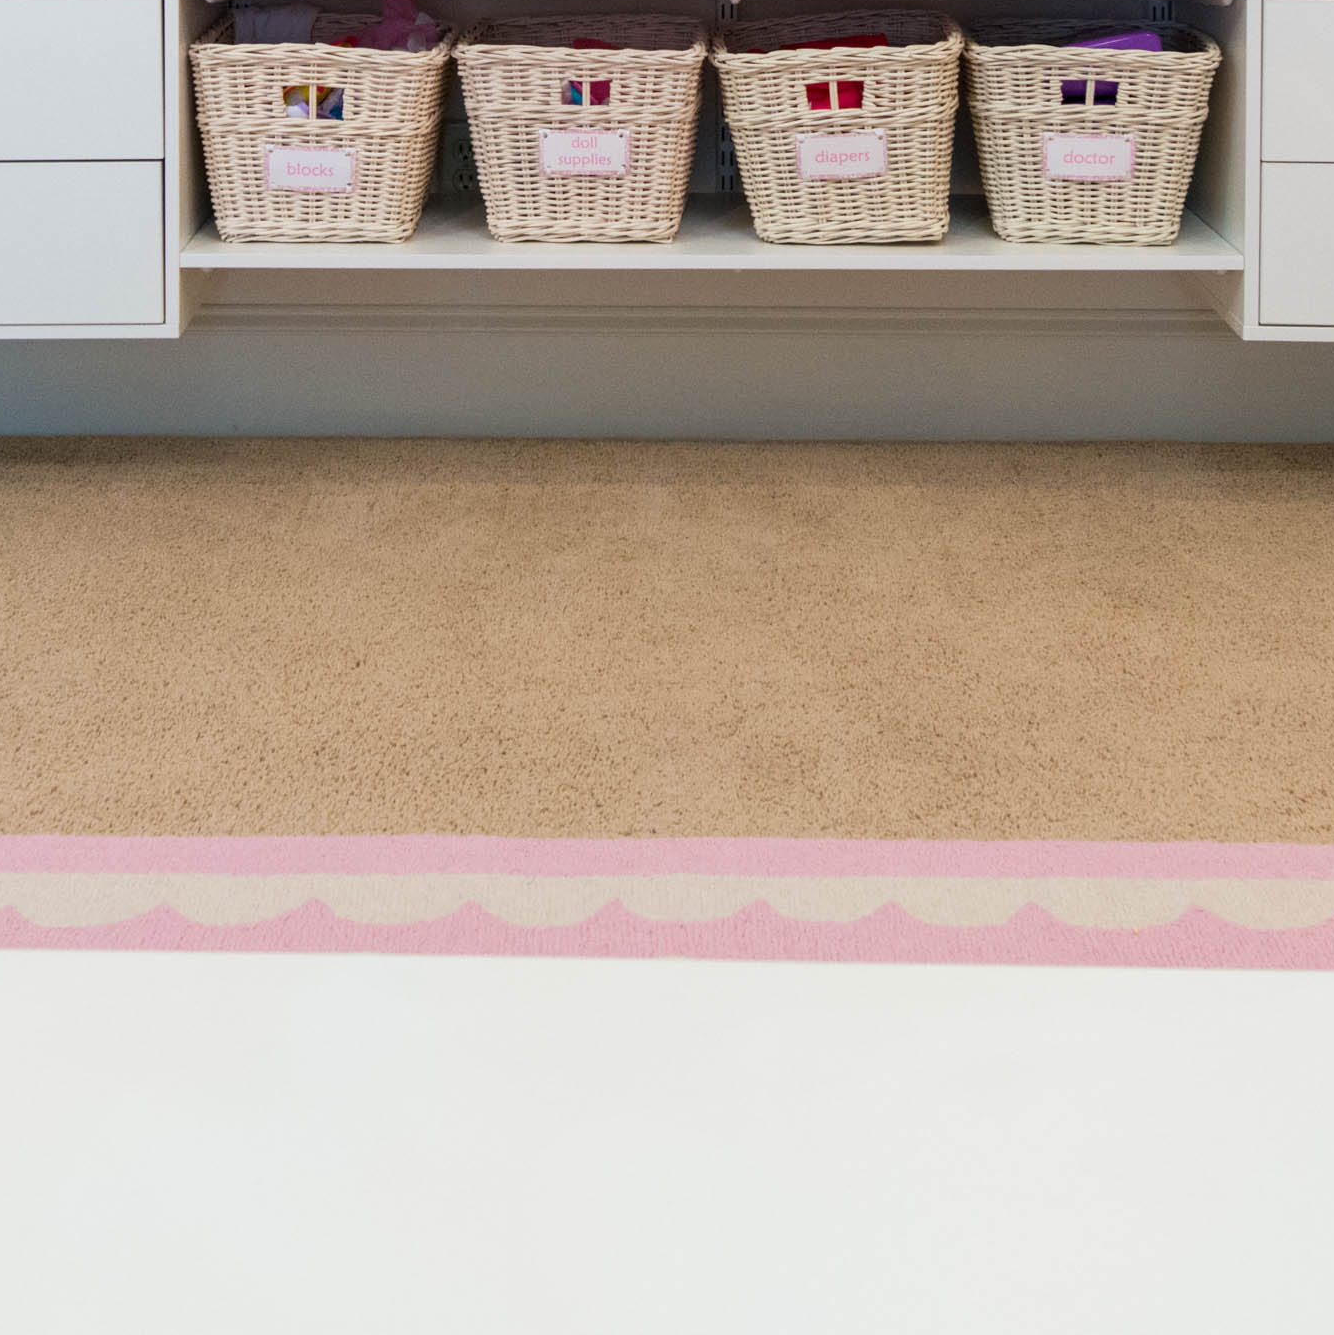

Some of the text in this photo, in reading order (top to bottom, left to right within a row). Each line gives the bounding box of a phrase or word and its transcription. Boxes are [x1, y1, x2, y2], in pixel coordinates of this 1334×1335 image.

[570, 137, 599, 149] doll
[557, 152, 612, 168] supplies
[814, 149, 870, 166] diapers
[1062, 150, 1116, 165] doctor
[287, 163, 333, 177] blocks
